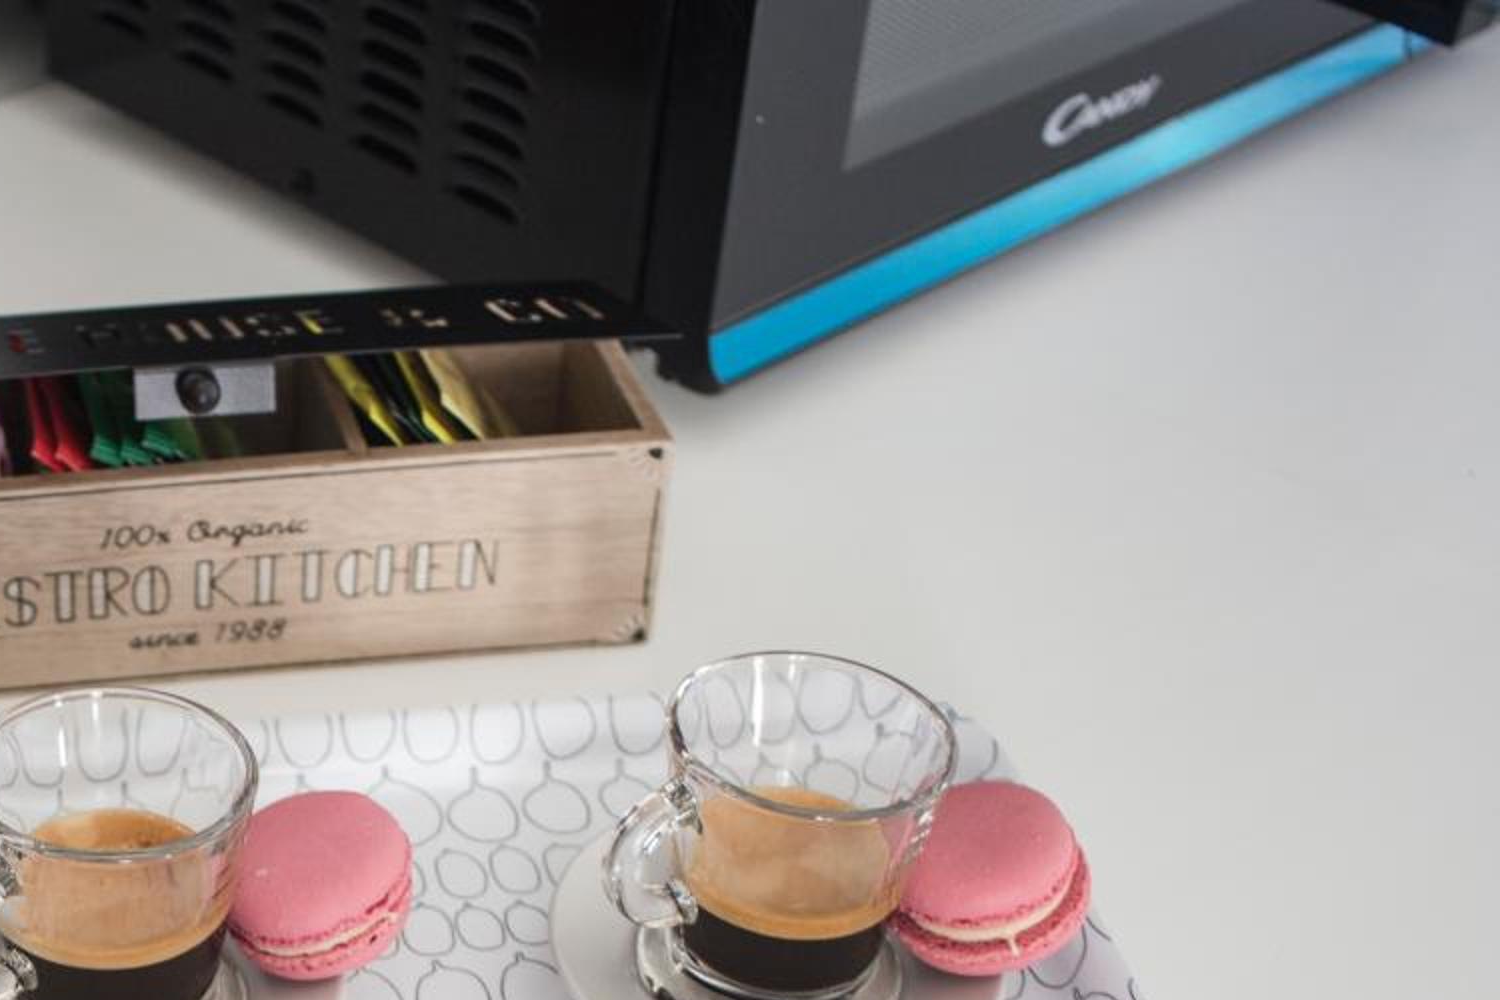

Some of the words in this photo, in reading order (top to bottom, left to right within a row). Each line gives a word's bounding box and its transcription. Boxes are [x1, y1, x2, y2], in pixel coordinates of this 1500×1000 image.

[187, 519, 309, 546] Organic
[194, 538, 500, 610] KITCHEN
[213, 617, 288, 643] 1988
